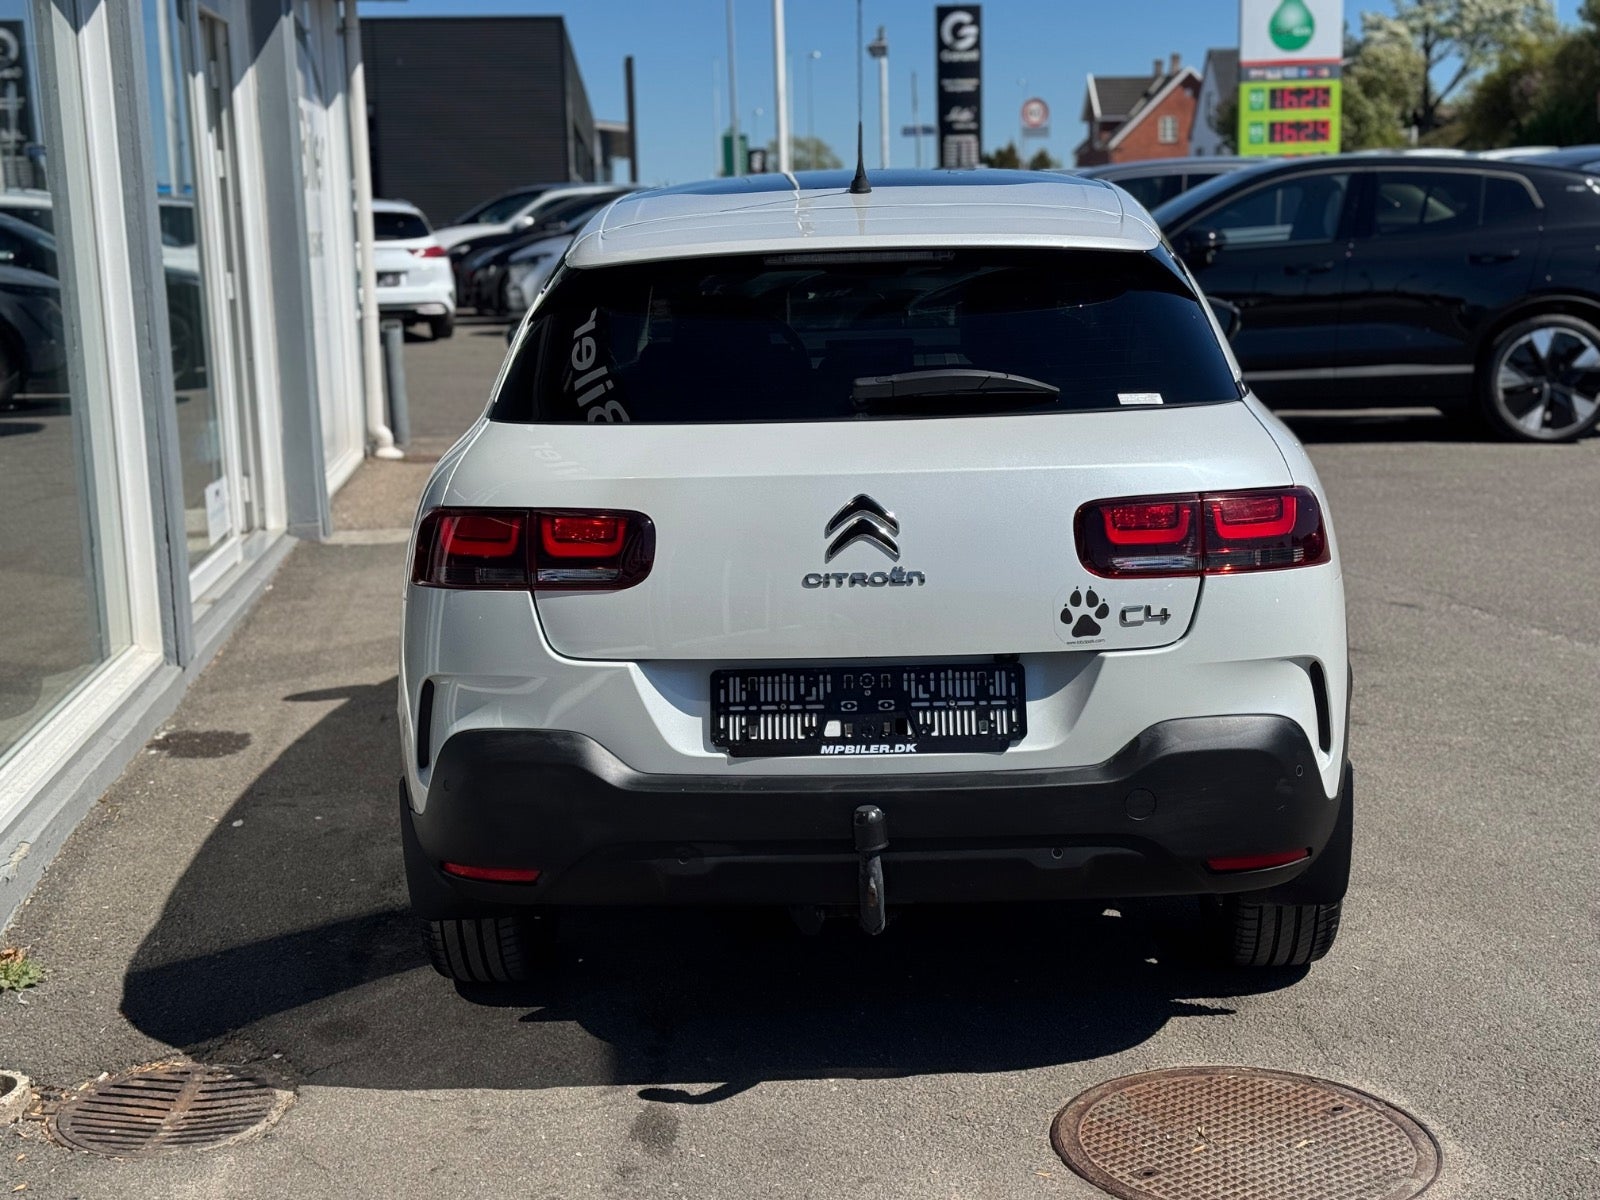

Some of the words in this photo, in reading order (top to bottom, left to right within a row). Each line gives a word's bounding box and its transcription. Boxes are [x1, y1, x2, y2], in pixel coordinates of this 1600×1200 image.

[940, 10, 980, 51] G
[1119, 604, 1172, 628] C4
[820, 743, 917, 755] MPBILER.DK
